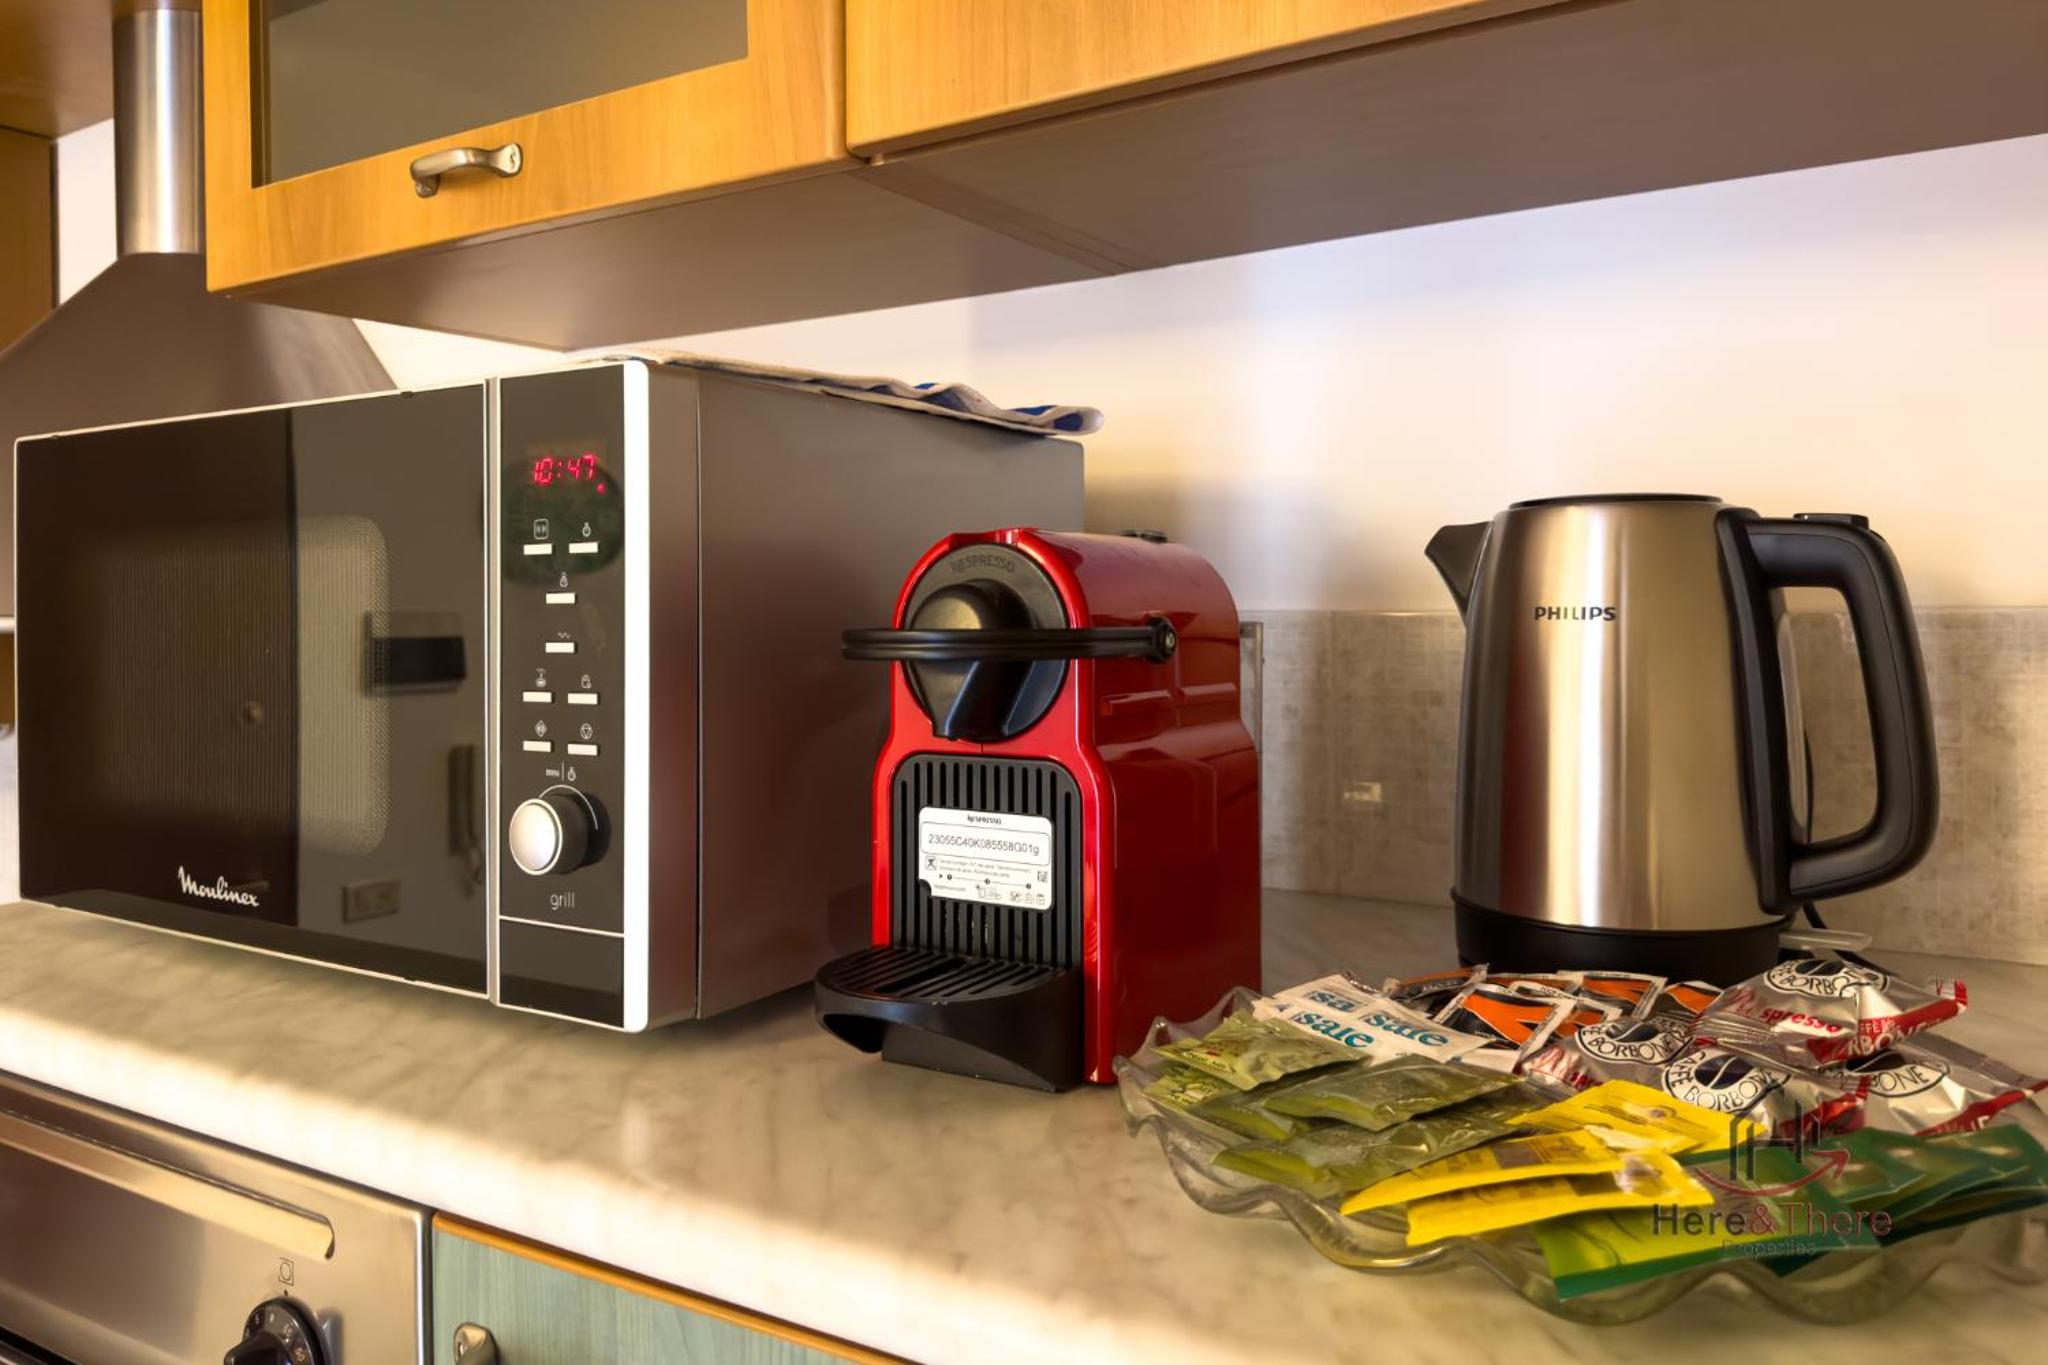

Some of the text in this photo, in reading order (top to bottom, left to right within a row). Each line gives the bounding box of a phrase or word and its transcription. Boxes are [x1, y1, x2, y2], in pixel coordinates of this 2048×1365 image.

[533, 454, 597, 484] 10:47
[1534, 606, 1617, 621] PHILIPS
[178, 865, 260, 907] Moulinex
[550, 892, 576, 910] grill
